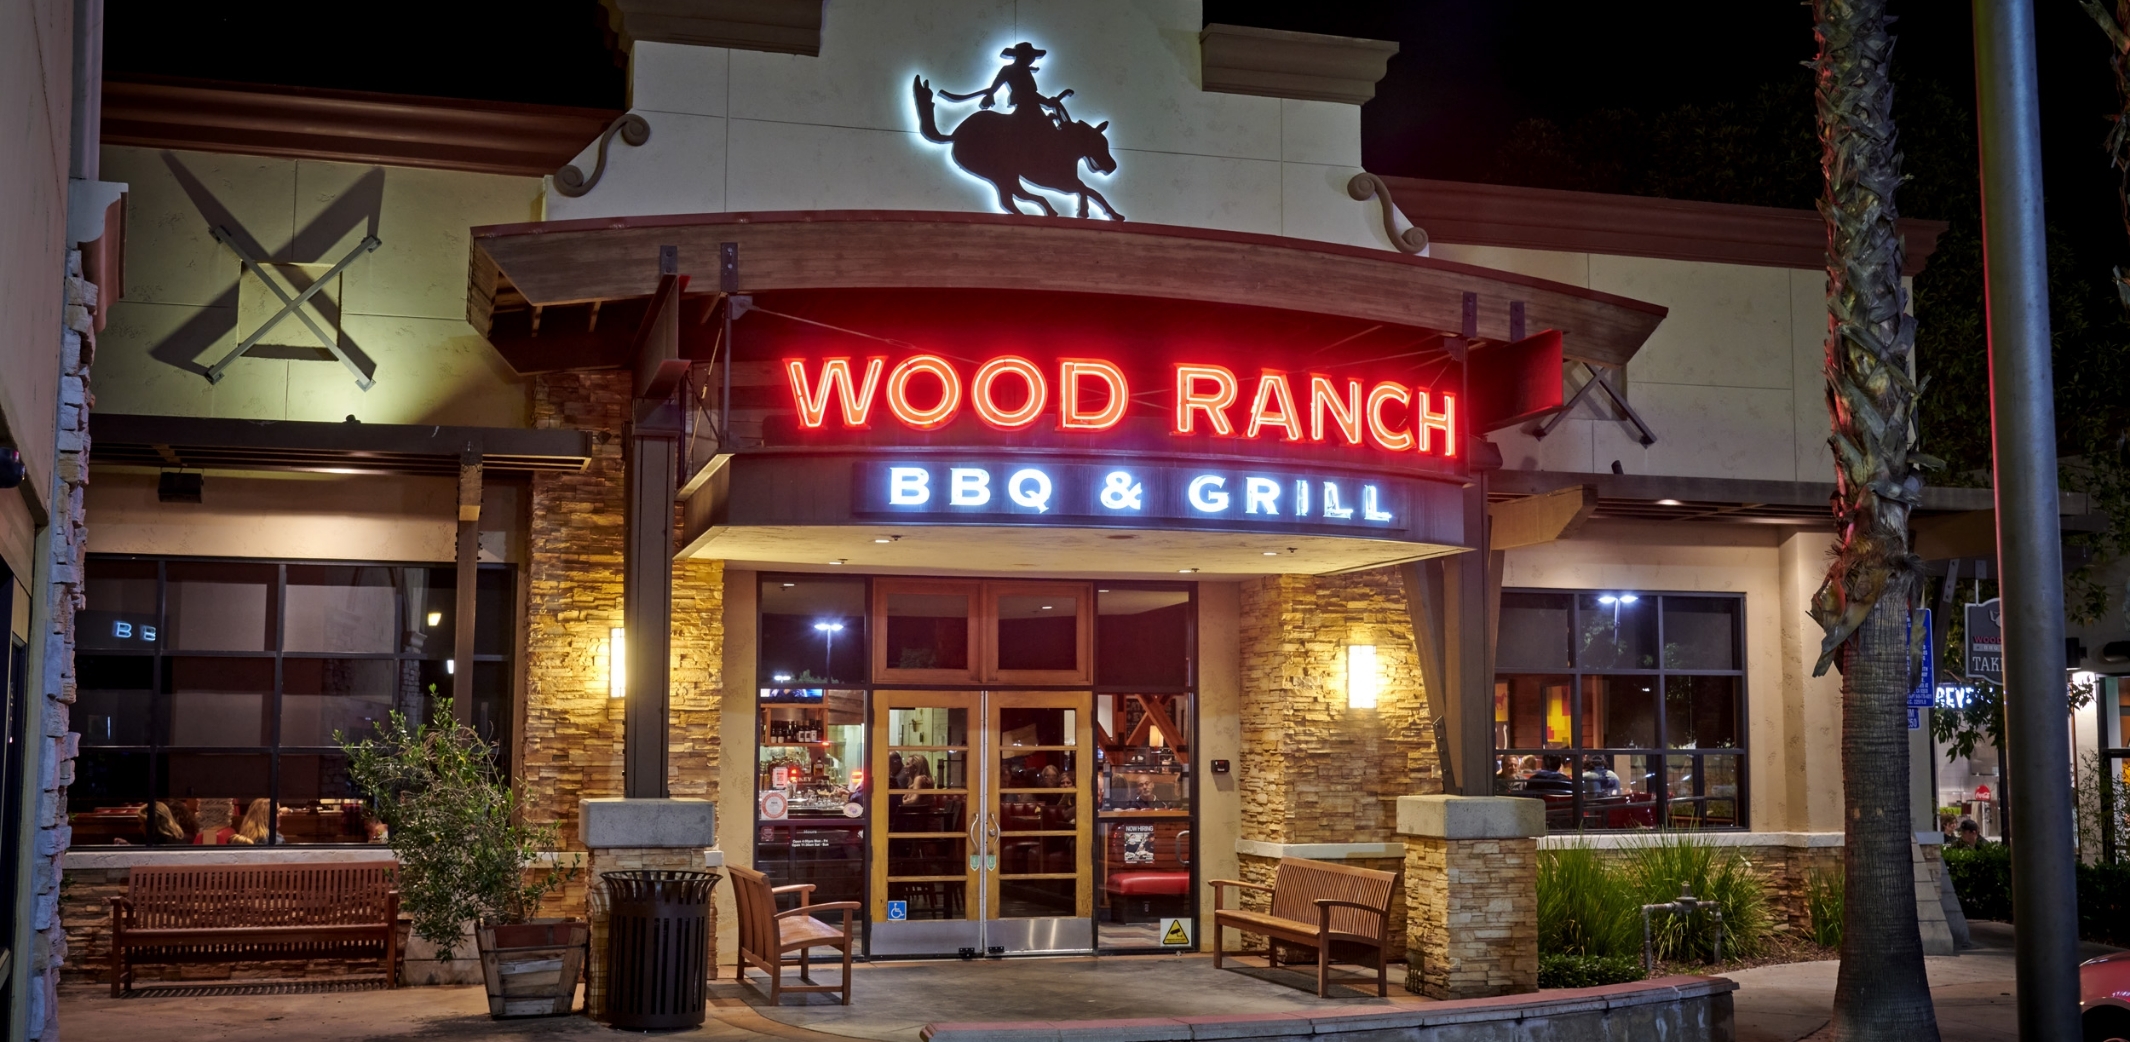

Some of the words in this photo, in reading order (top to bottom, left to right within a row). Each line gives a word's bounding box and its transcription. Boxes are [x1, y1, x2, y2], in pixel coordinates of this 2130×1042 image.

[783, 355, 1130, 432] WOOD
[1170, 362, 1457, 459] RANCH
[888, 467, 1050, 515] BBQ
[1100, 471, 1142, 510] &
[1187, 475, 1393, 523] GRILL
[1974, 635, 2002, 644] WOOD
[1972, 656, 2003, 672] TAK
